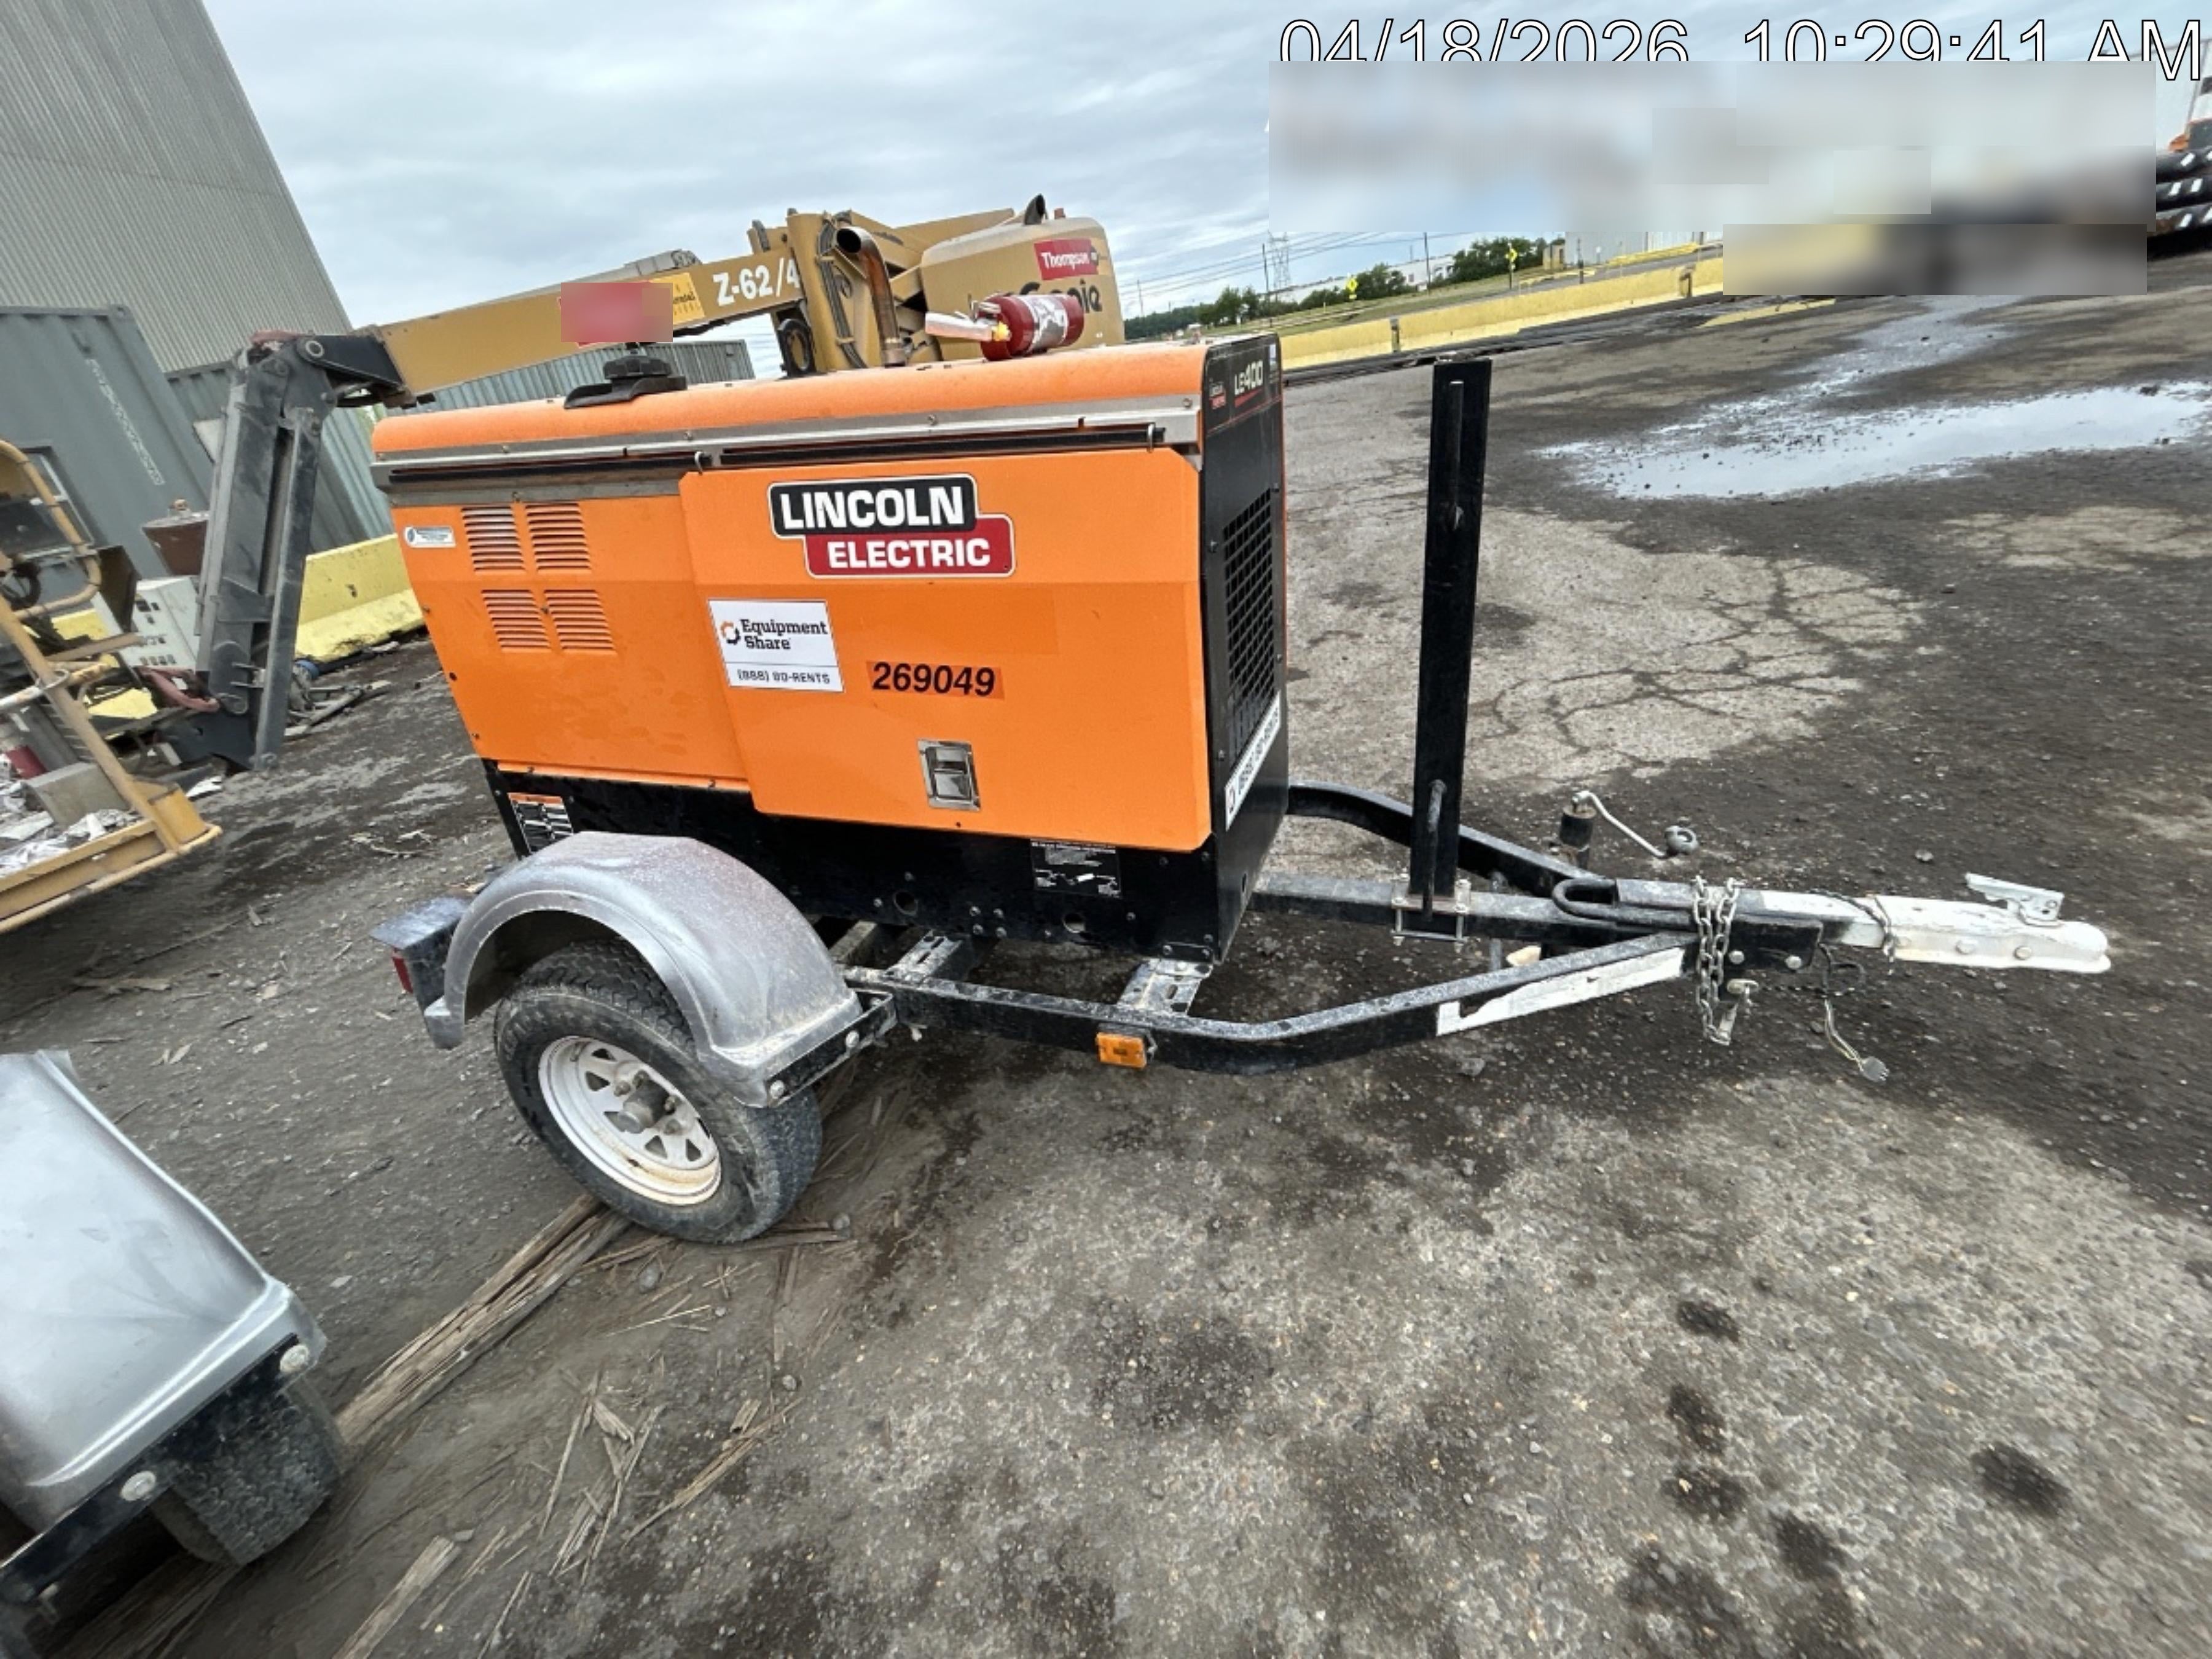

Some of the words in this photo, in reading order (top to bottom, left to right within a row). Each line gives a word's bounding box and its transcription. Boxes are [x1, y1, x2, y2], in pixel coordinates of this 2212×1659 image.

[780, 486, 965, 530] LINCOLN
[827, 538, 991, 569] ELECTRIC
[740, 619, 828, 637] Equipment
[744, 635, 791, 649] Share
[872, 661, 995, 697] 269049
